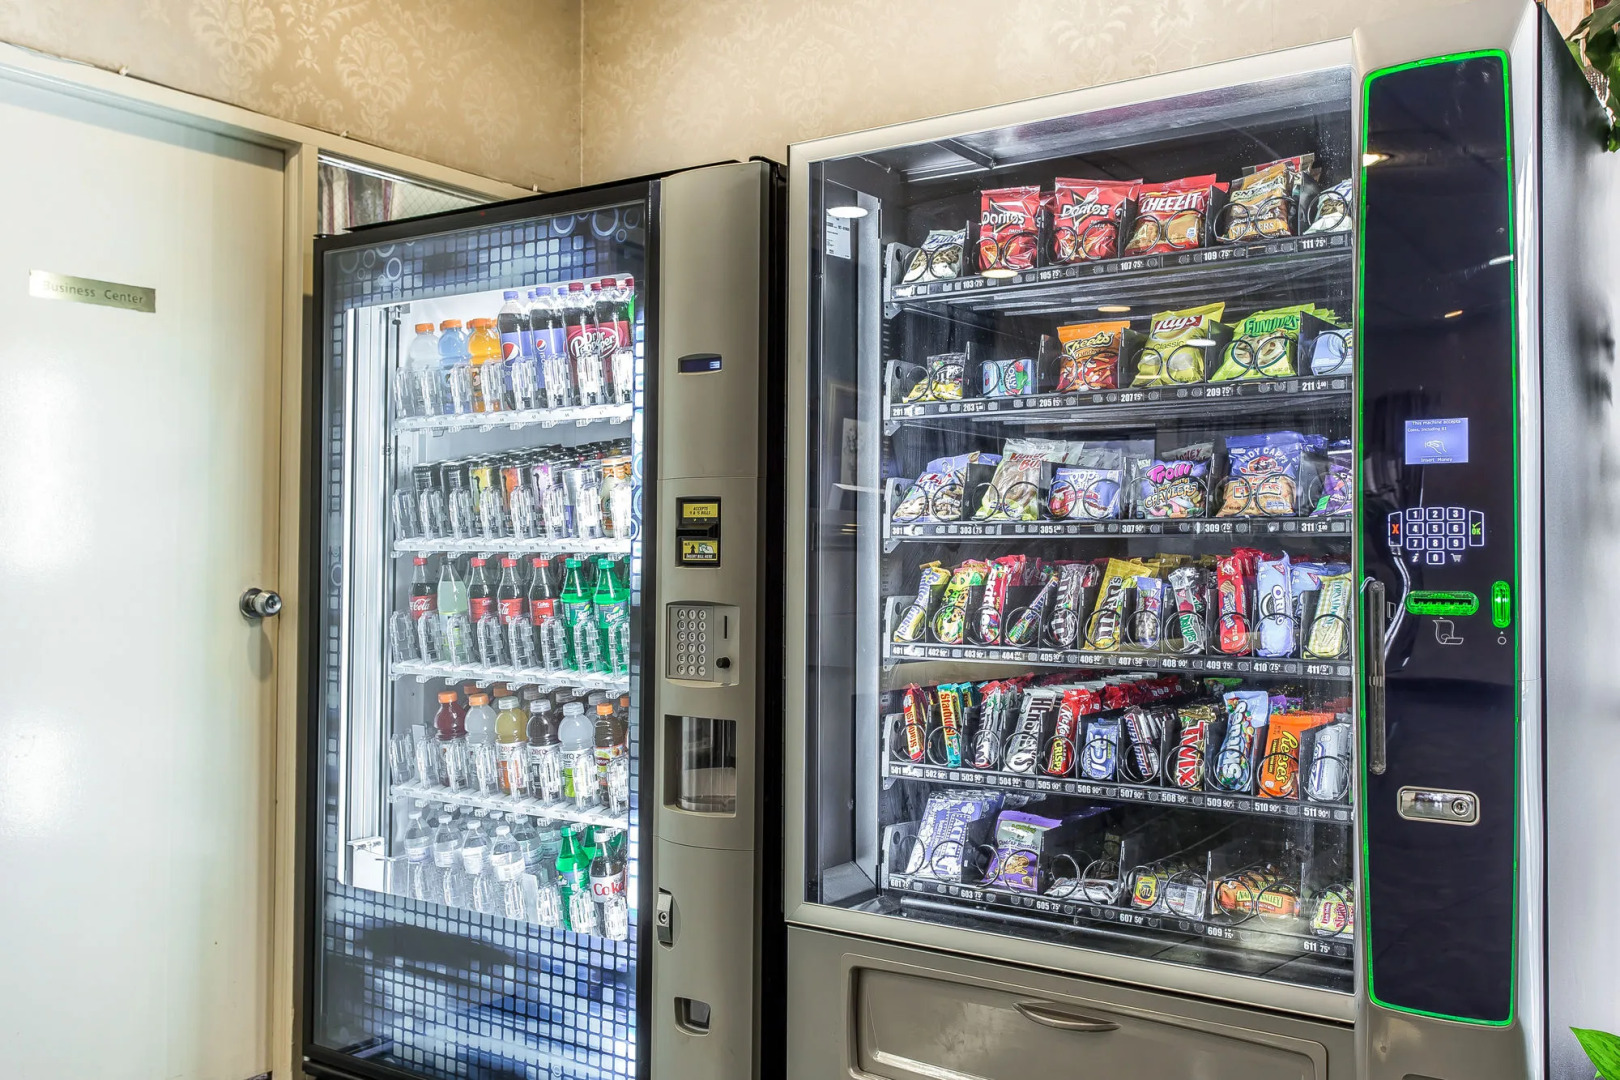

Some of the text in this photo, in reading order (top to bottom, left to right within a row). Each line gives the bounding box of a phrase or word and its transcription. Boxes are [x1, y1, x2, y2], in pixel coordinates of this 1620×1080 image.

[1060, 204, 1110, 217] Doritos
[982, 211, 1025, 226] Doritos
[1302, 240, 1314, 249] 111
[1204, 251, 1217, 260] 109
[1120, 261, 1132, 271] 107
[963, 281, 974, 289] 103
[43, 280, 144, 304] Business Center
[1153, 339, 1185, 350] Classic
[1302, 382, 1315, 391] 211
[1206, 388, 1221, 397] 209
[1120, 394, 1133, 402] 207
[1039, 399, 1052, 407] 205
[1412, 511, 1418, 519] 1
[1453, 510, 1459, 518] 3
[1040, 525, 1053, 534] 305
[1121, 524, 1135, 533] 307
[1205, 524, 1219, 533] 309
[1301, 523, 1315, 532] 311
[1412, 525, 1418, 533] 4
[1432, 525, 1438, 533] 5
[1412, 539, 1459, 547] 7 8 9
[1272, 584, 1286, 626] OREO
[928, 648, 939, 656] 402
[964, 650, 976, 658] 403
[1002, 652, 1015, 660] 404
[1040, 653, 1053, 662] 405
[1080, 655, 1093, 664] 406
[1118, 657, 1131, 666] 407
[1162, 660, 1176, 668] 408
[1206, 661, 1221, 669] 409
[1253, 662, 1267, 672] 410
[1307, 665, 1319, 674] 411
[940, 693, 957, 736] Starburst
[1090, 732, 1107, 772] ICE
[1275, 731, 1299, 783] Reese's
[891, 766, 901, 774] 501
[925, 769, 937, 778] 502
[961, 773, 973, 782] 503
[999, 777, 1012, 785] 504
[1038, 781, 1050, 790] 505
[1078, 785, 1091, 793] 506
[1120, 789, 1133, 798] 507
[1161, 793, 1176, 802] 508
[1206, 797, 1221, 807] 509
[1254, 802, 1269, 812] 510
[1303, 807, 1317, 816] 511
[890, 879, 902, 888] 601
[961, 889, 973, 899] 603
[1036, 900, 1049, 910] 605
[1120, 914, 1132, 923] 607
[1207, 927, 1222, 937] 609
[1303, 941, 1317, 951] 611
